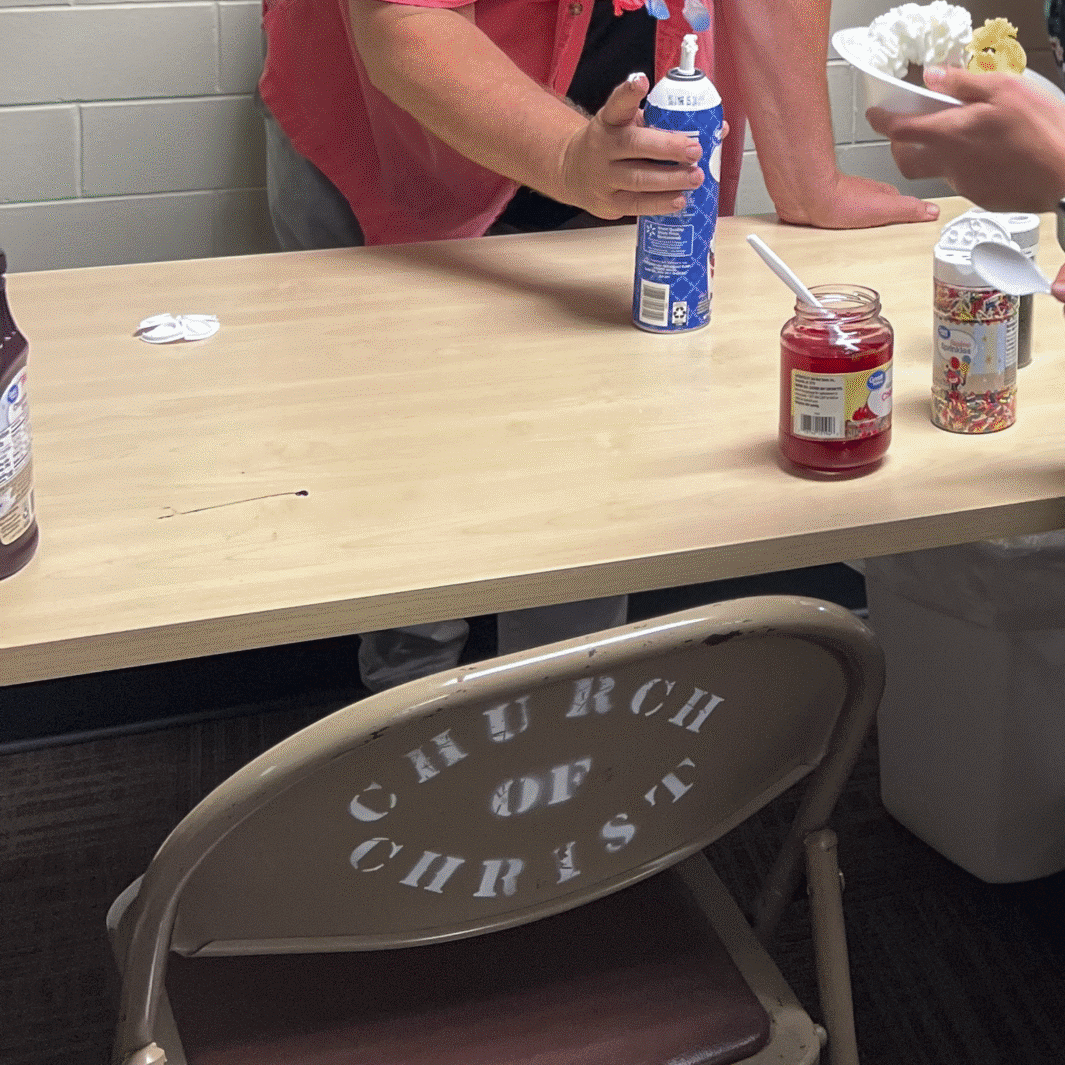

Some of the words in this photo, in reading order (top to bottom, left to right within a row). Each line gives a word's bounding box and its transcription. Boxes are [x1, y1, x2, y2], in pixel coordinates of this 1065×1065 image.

[349, 675, 725, 822] CHURCH
[490, 754, 594, 817] OF
[349, 757, 697, 899] CHRIST
